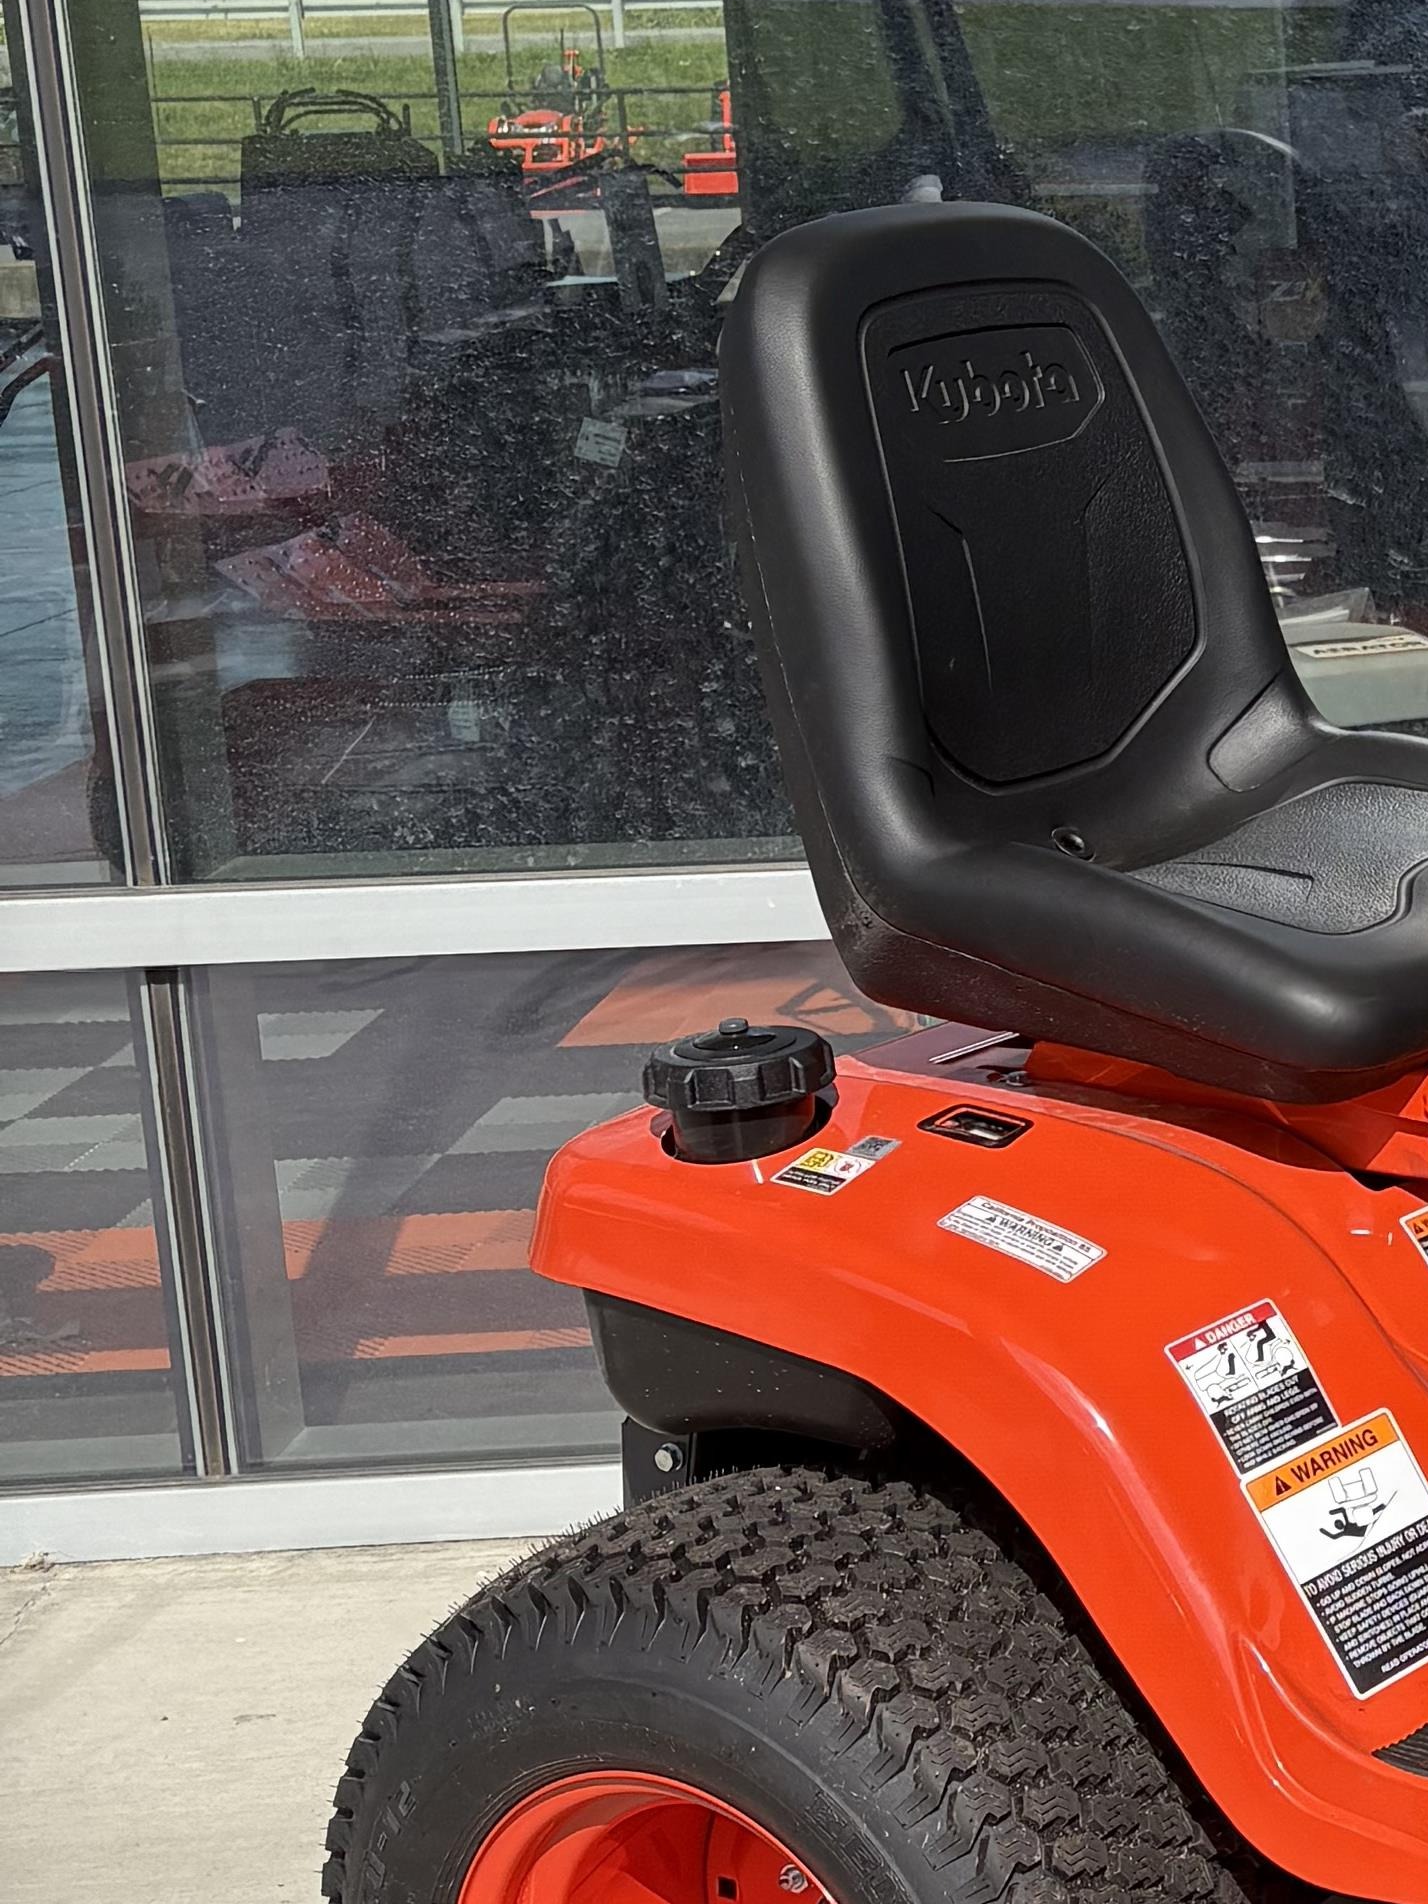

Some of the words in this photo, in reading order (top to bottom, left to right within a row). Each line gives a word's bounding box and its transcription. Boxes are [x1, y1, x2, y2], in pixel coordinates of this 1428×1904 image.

[901, 350, 1080, 426] Kubota
[998, 1217, 1054, 1247] WARNING
[1203, 1312, 1256, 1344] DANGER
[1289, 1426, 1379, 1485] WARNING
[1303, 1581, 1319, 1599] TO
[1314, 1568, 1343, 1592] AVOID
[1339, 1548, 1379, 1578] SERIOUS
[1374, 1532, 1407, 1558] INJURY
[1402, 1525, 1419, 1543] OR
